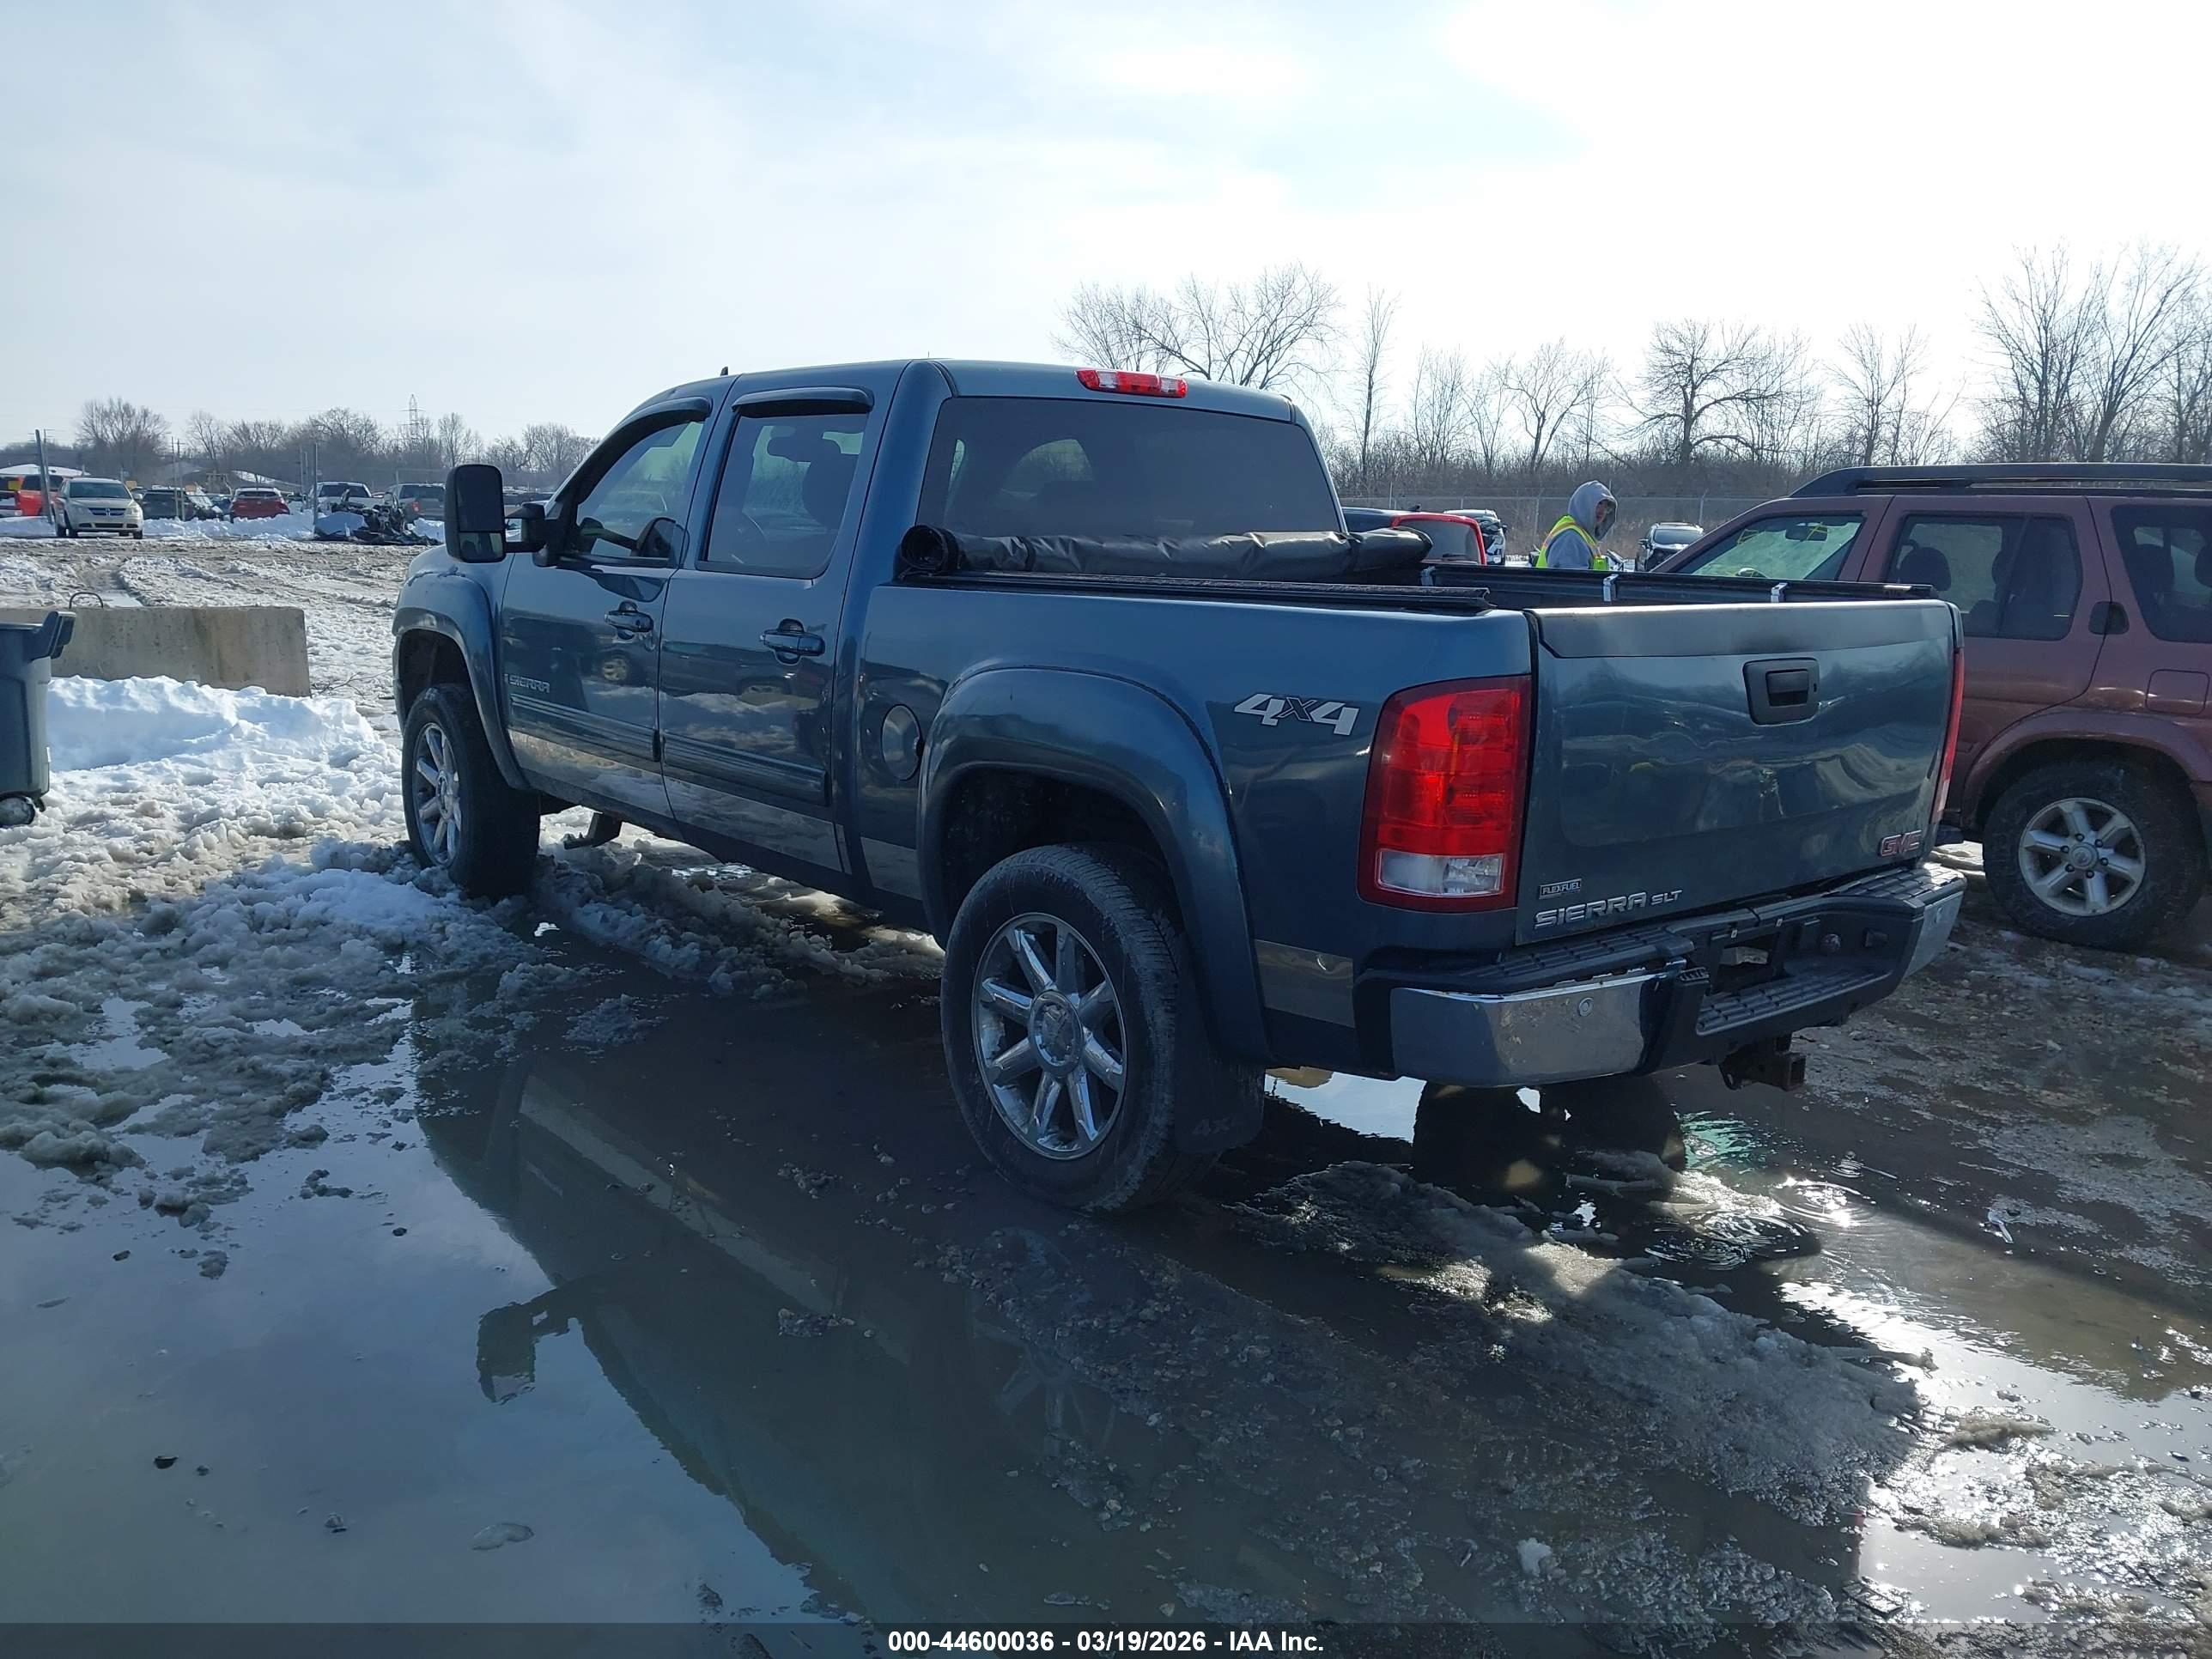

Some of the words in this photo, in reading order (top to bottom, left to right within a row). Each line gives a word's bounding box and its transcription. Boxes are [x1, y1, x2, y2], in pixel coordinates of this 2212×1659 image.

[509, 674, 550, 694] SIERRA
[1881, 830, 1922, 857] GMC
[1534, 891, 1647, 929] SIERRA
[1650, 890, 1683, 906] SLT
